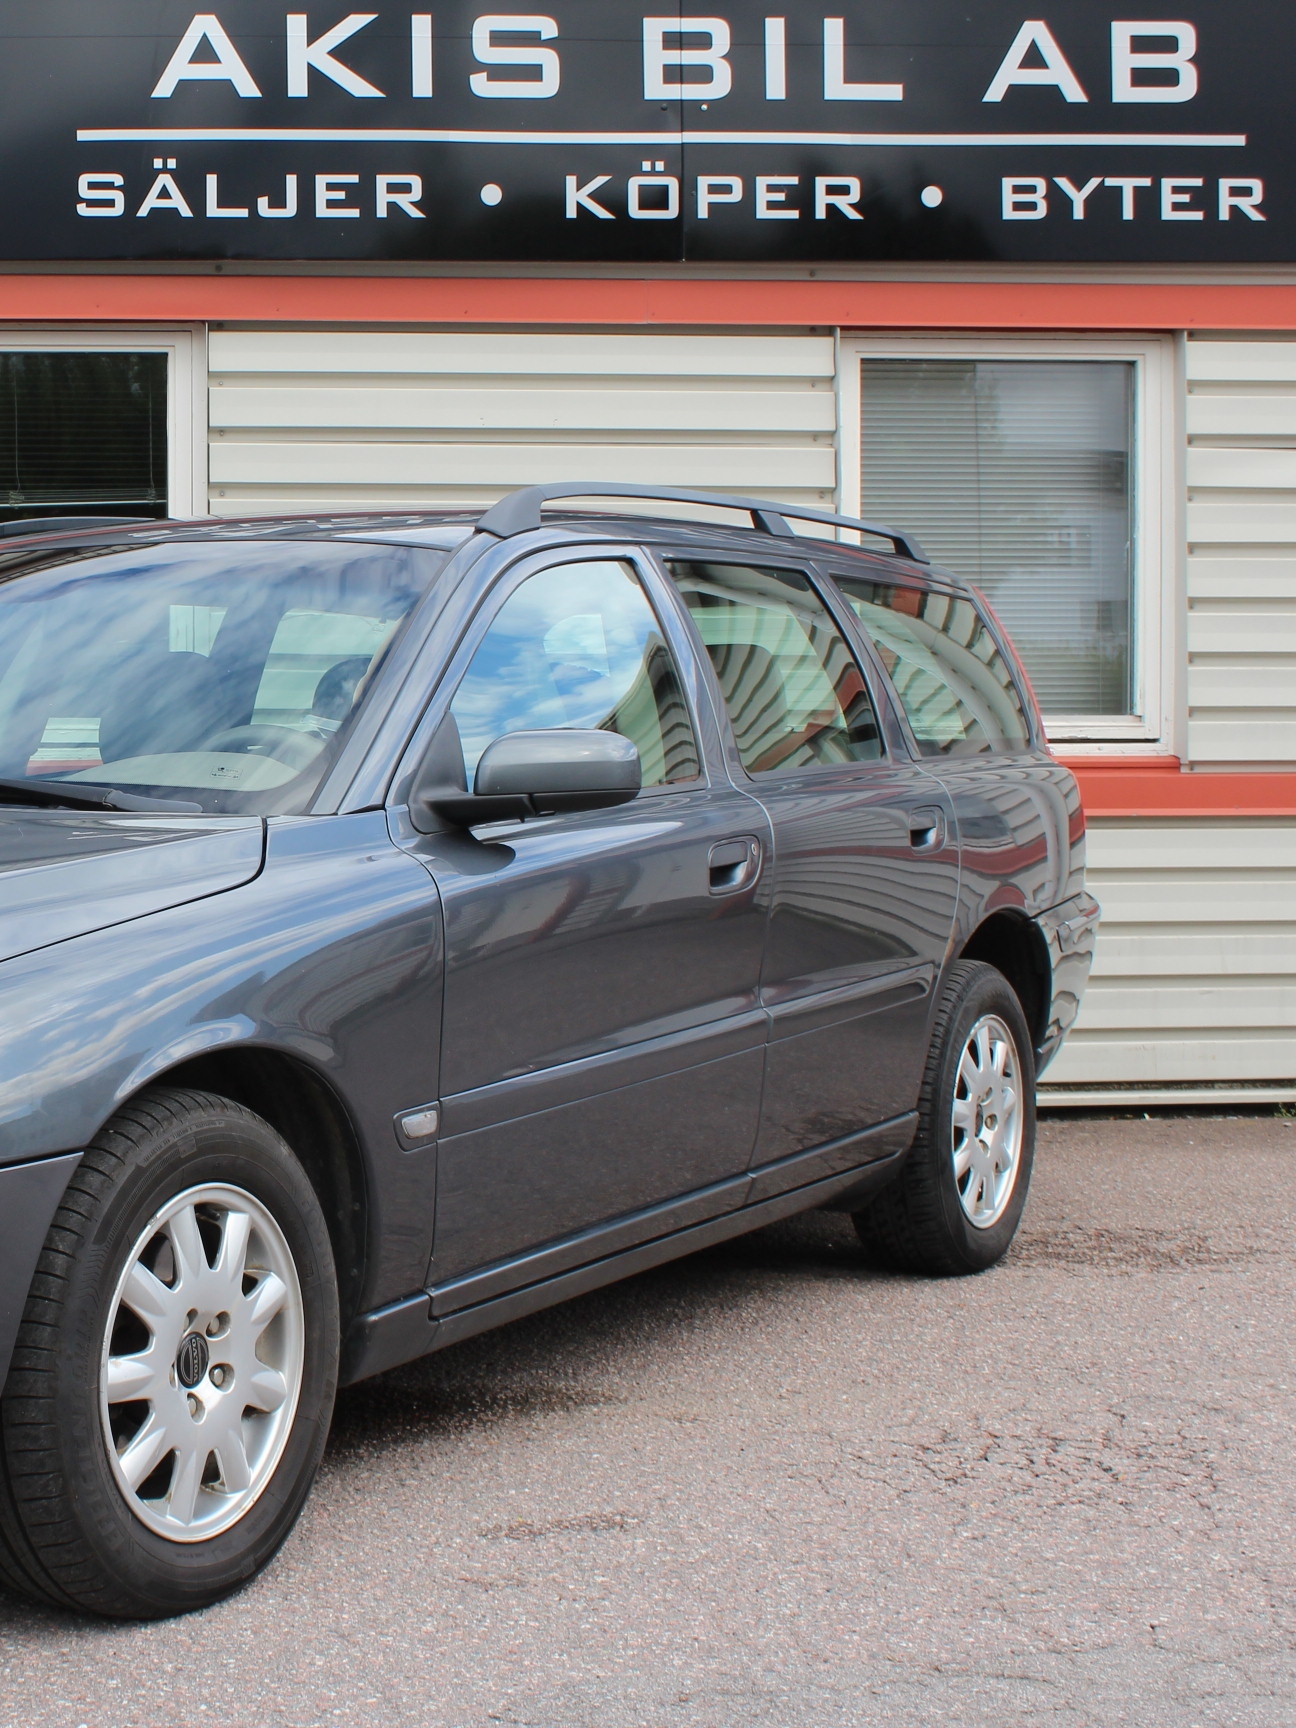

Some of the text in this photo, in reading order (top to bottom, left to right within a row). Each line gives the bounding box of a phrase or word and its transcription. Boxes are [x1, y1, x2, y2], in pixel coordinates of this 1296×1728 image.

[150, 13, 1197, 104] AKIS BIL AB
[76, 158, 1266, 222] SÄLJER KÖPER BYTER
